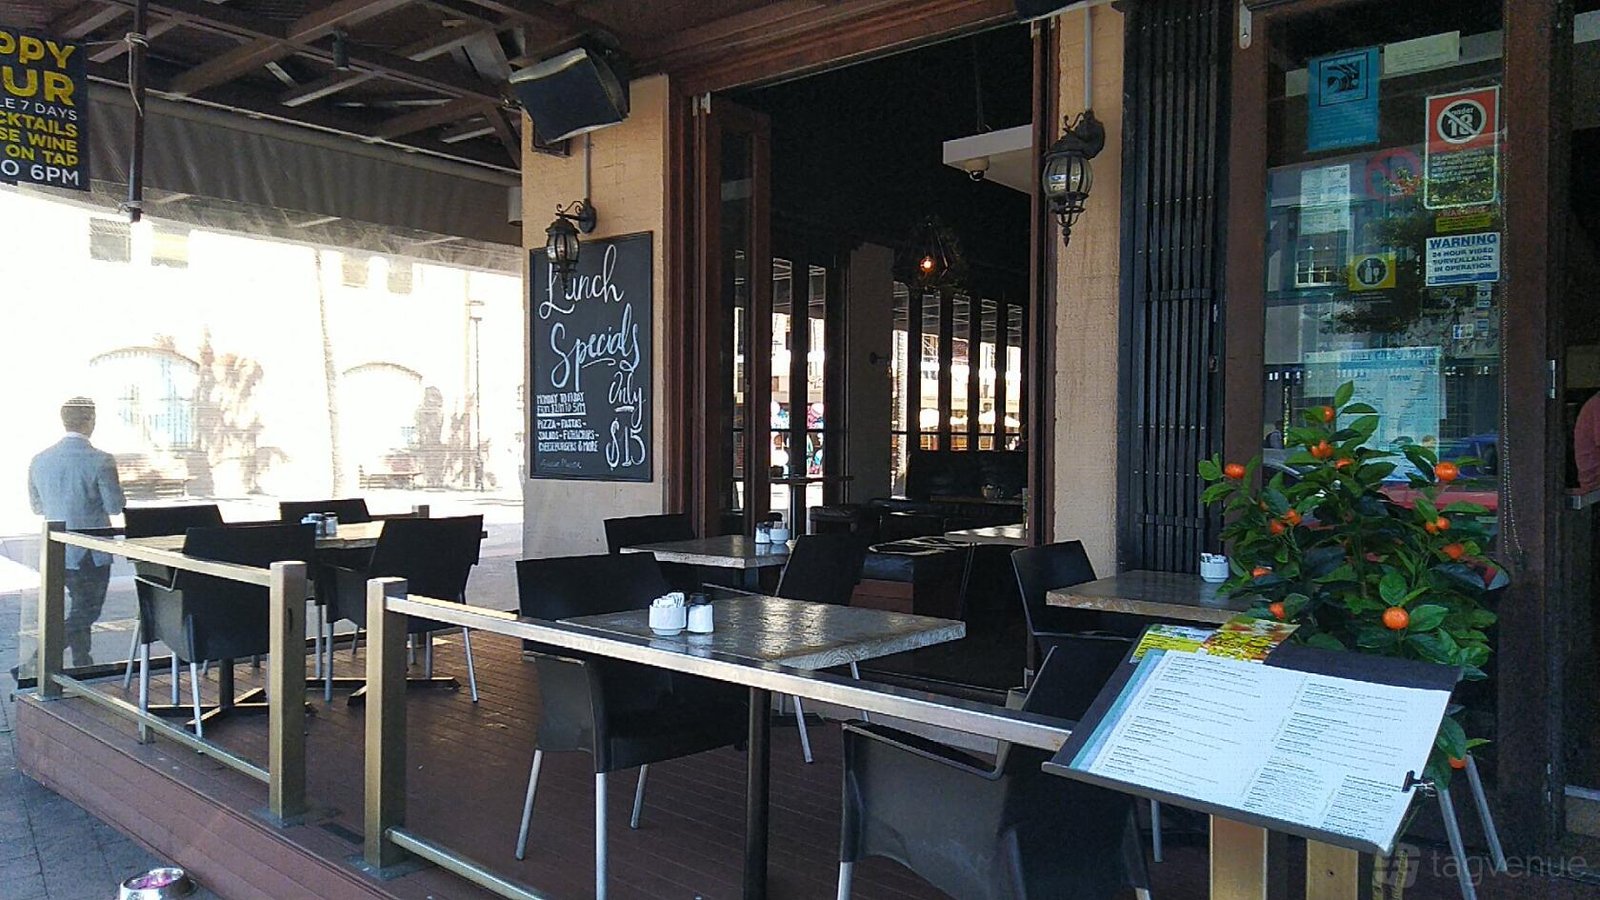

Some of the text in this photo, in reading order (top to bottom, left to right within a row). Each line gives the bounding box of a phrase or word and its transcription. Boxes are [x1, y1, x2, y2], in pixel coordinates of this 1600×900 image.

[2, 66, 75, 106] UR
[20, 100, 30, 111] 7
[35, 103, 78, 121] DAYS
[1448, 113, 1473, 137] 18
[27, 131, 78, 153] WINE
[5, 143, 78, 167] ON TAP
[30, 164, 80, 186] 6PM
[1430, 234, 1497, 250] WARNING
[1443, 249, 1467, 257] HOUR
[1468, 247, 1494, 255] VIDEO
[1433, 255, 1493, 265] SURVEILLANCE
[1444, 263, 1492, 272] OPERATION
[539, 244, 624, 320] Lunch
[551, 302, 641, 392] Specials
[608, 371, 647, 428] Only
[606, 417, 646, 471] $15
